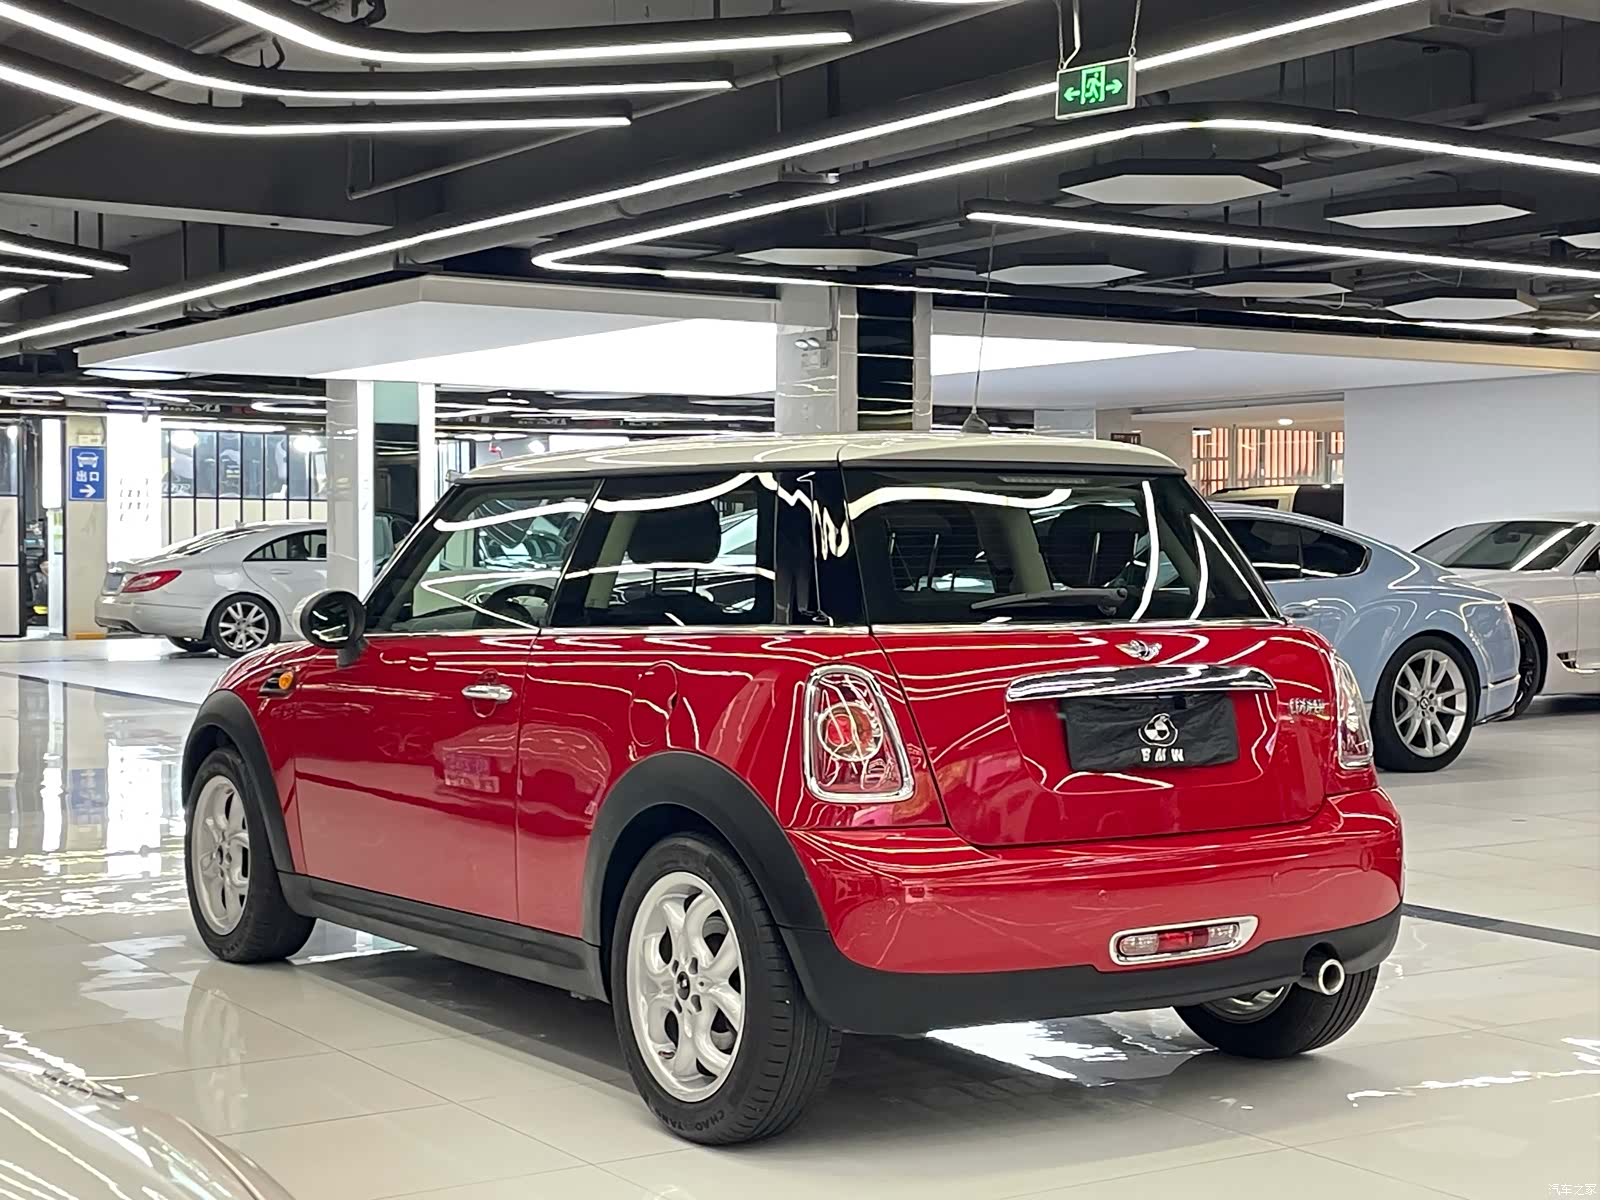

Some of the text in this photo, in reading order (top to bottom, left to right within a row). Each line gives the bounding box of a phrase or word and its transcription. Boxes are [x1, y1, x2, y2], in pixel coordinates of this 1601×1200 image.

[76, 470, 100, 482] 出口
[1141, 748, 1185, 762] BMW
[695, 1110, 725, 1131] CHAO
